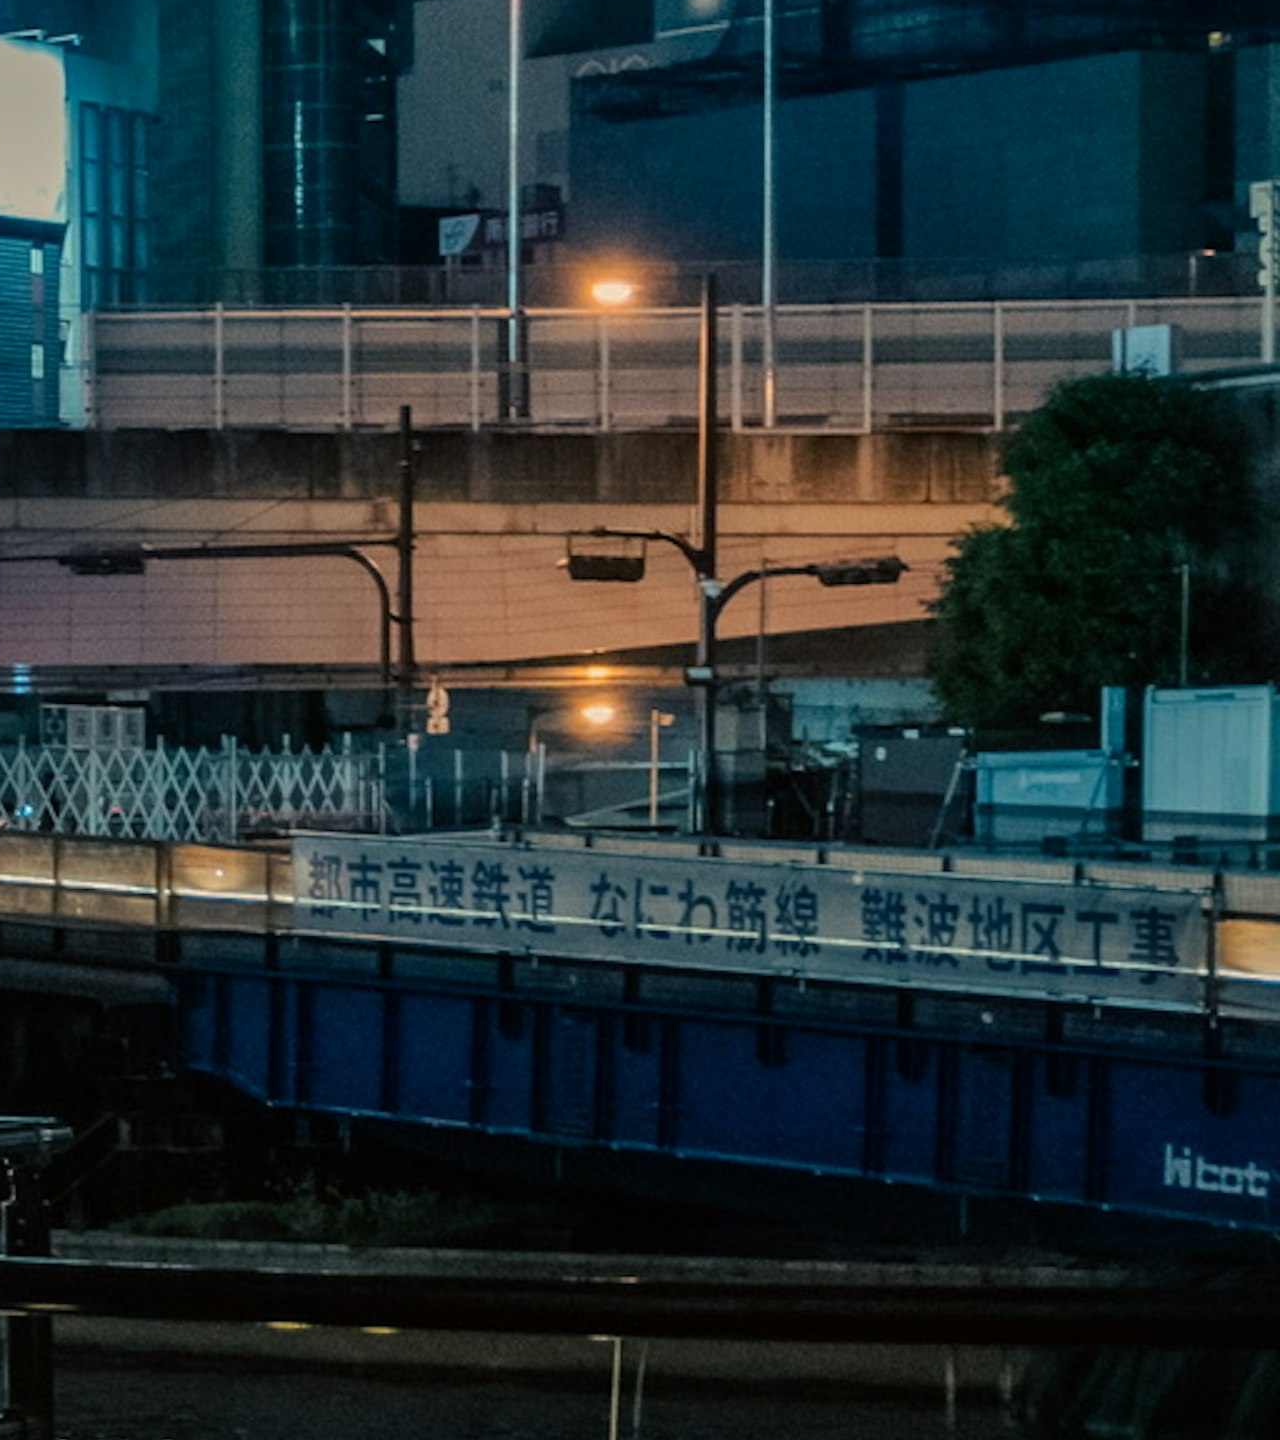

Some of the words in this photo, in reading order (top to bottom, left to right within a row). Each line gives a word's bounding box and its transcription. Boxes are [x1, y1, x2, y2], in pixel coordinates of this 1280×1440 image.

[308, 852, 557, 934] 都市高速鉄道
[590, 873, 821, 958] なにわ筋線
[860, 888, 1180, 986] 難波地区工事
